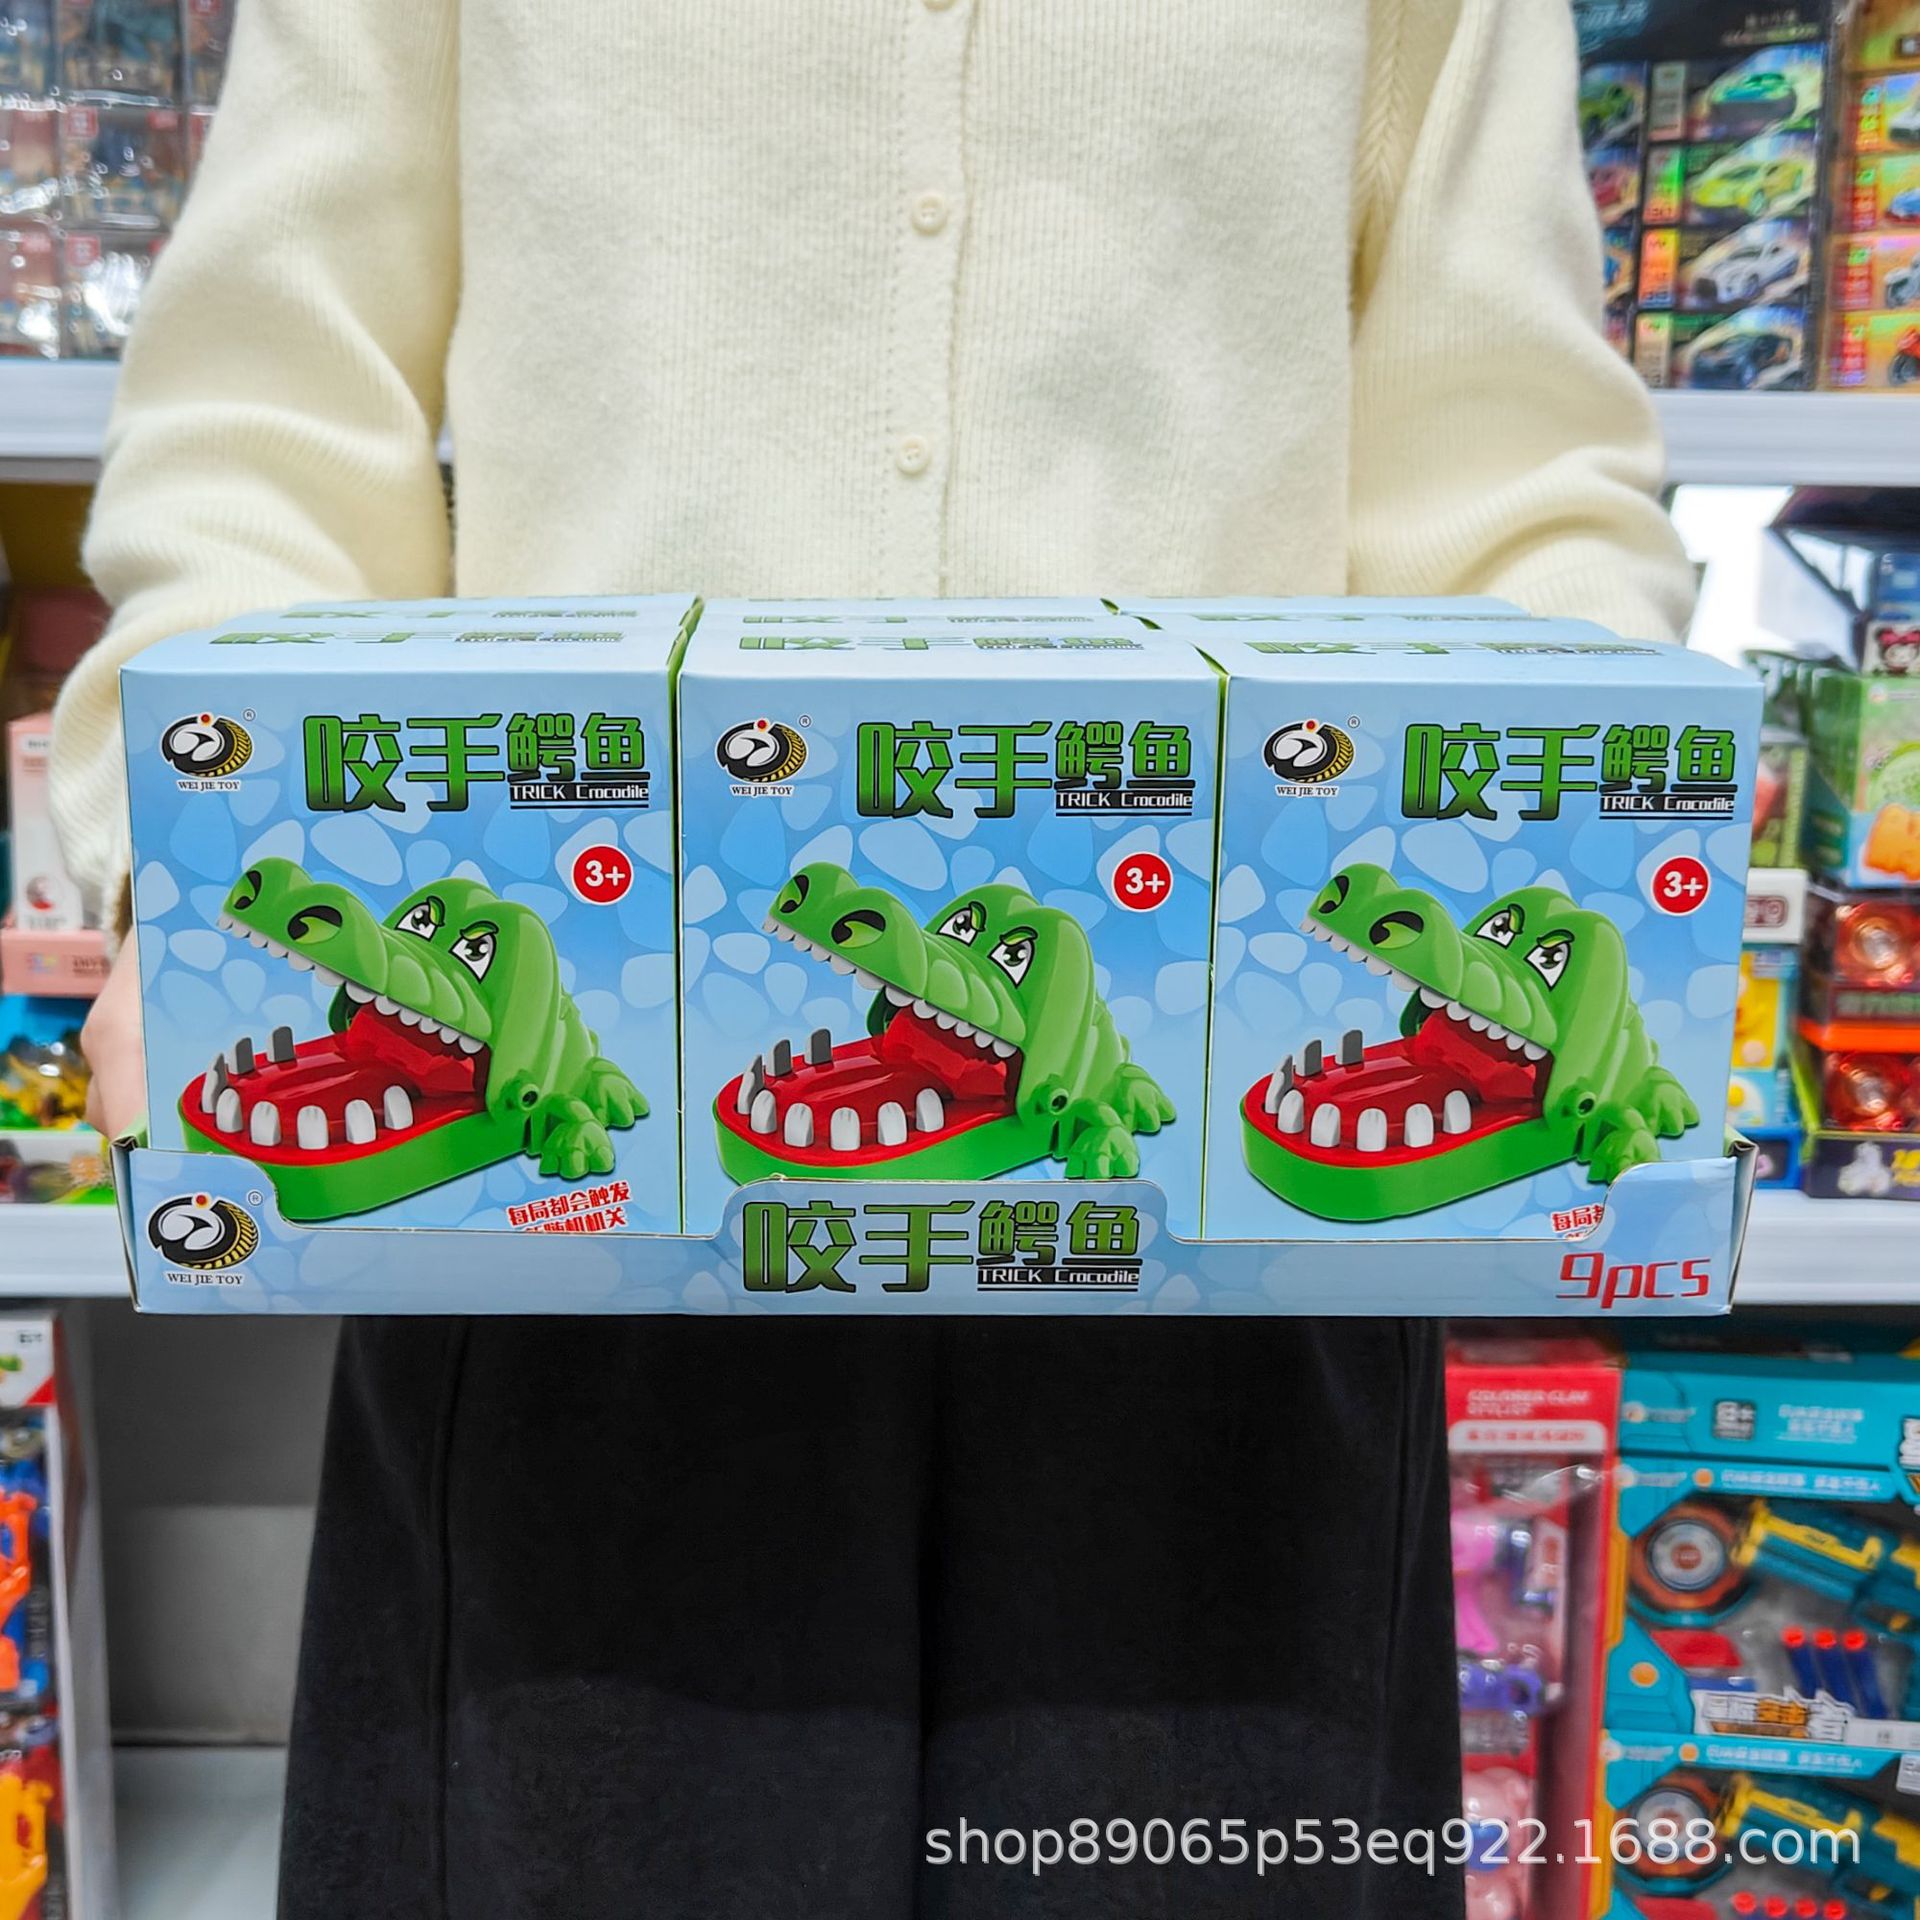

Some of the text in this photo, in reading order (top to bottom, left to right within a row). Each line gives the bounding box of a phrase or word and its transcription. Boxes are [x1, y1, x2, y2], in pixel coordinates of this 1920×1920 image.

[303, 713, 650, 813] 咬手鳄鱼
[856, 721, 1196, 818] 咬手鳄鱼
[1400, 723, 1738, 821] 咬手鳄鱼
[177, 781, 240, 791] WEI JIE TOY
[510, 784, 649, 800] TRICK Crocodile
[731, 786, 793, 797] WEI JIE TOY
[1057, 791, 1193, 808] TRICK Crocodile
[1276, 786, 1338, 797] WEI JIE TOY
[1601, 795, 1734, 812] TRICK Crocodile
[585, 860, 626, 887] 3+
[1125, 867, 1166, 894] 3+
[1663, 870, 1704, 898] 3+
[508, 1181, 630, 1226] 每局都会触发
[743, 1200, 1142, 1293] 咬手鳄鱼
[167, 1273, 243, 1286] WEI JIE TOY
[979, 1268, 1140, 1284] TRICK Crocodile
[1555, 1252, 1711, 1309] 9pcs
